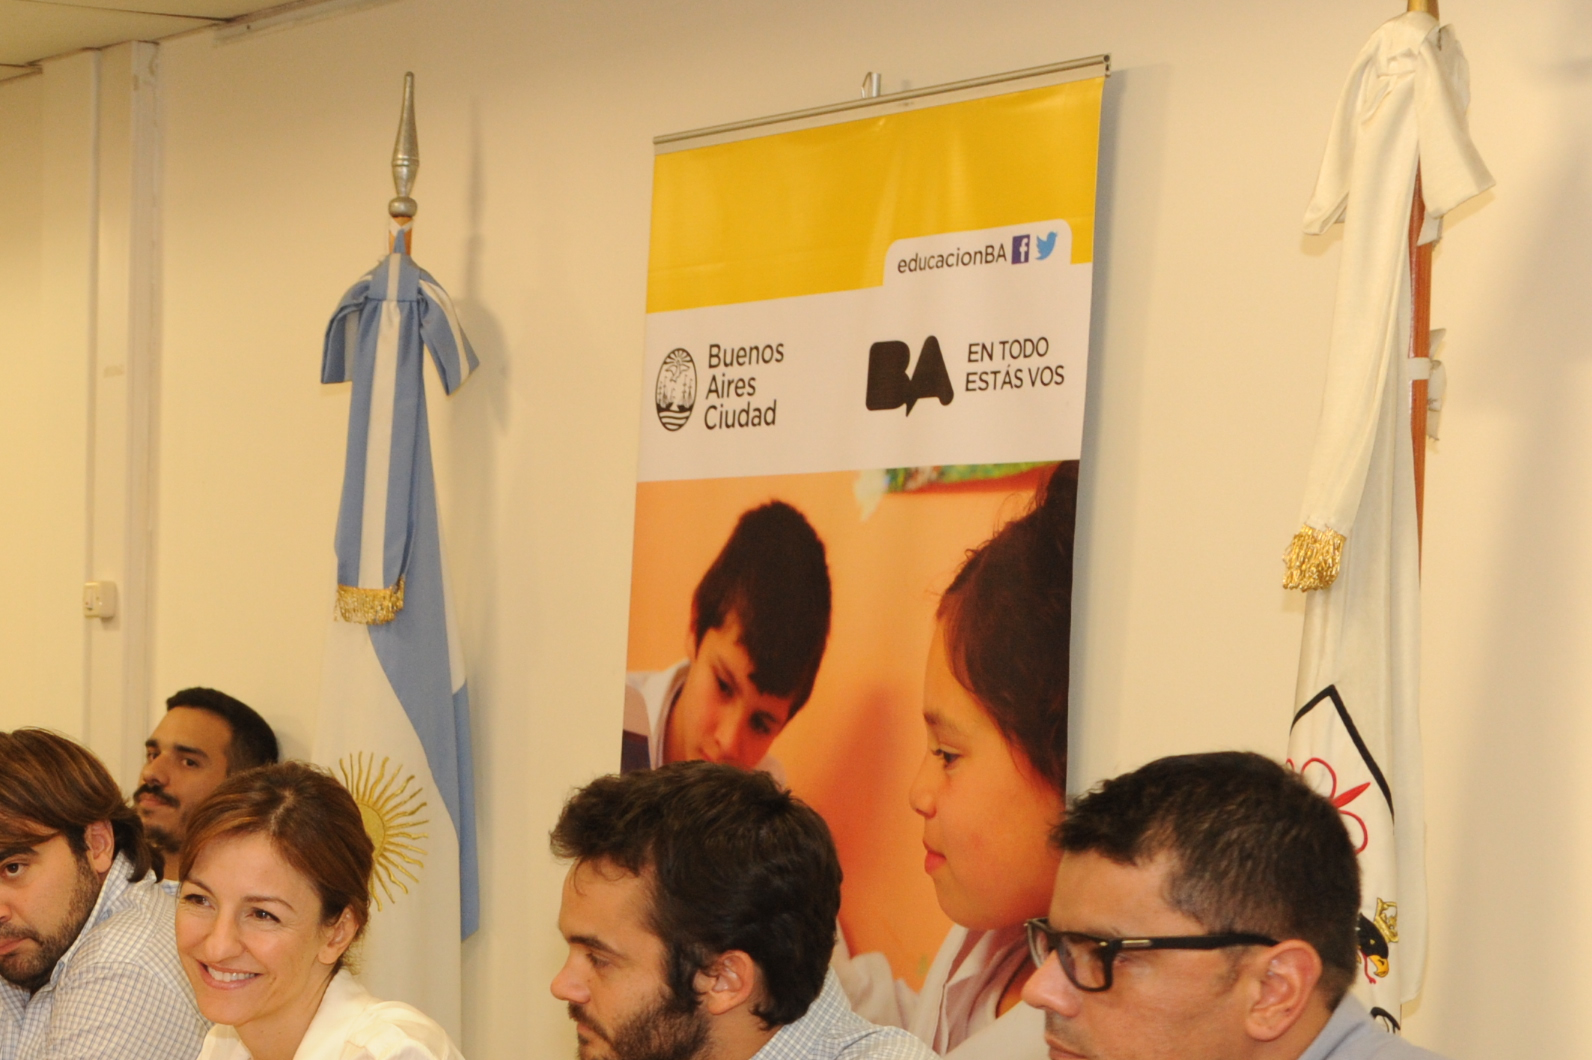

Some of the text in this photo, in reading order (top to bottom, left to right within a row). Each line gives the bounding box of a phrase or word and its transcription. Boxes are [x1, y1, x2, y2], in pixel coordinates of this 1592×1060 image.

[897, 243, 1007, 275] educacionBA
[708, 341, 785, 369] Buenos
[967, 336, 1049, 363] EN TODO
[704, 373, 757, 399] Aires
[865, 334, 955, 417] BA
[964, 363, 1065, 392] ESTÁS VOS
[703, 400, 777, 431] Ciudad
